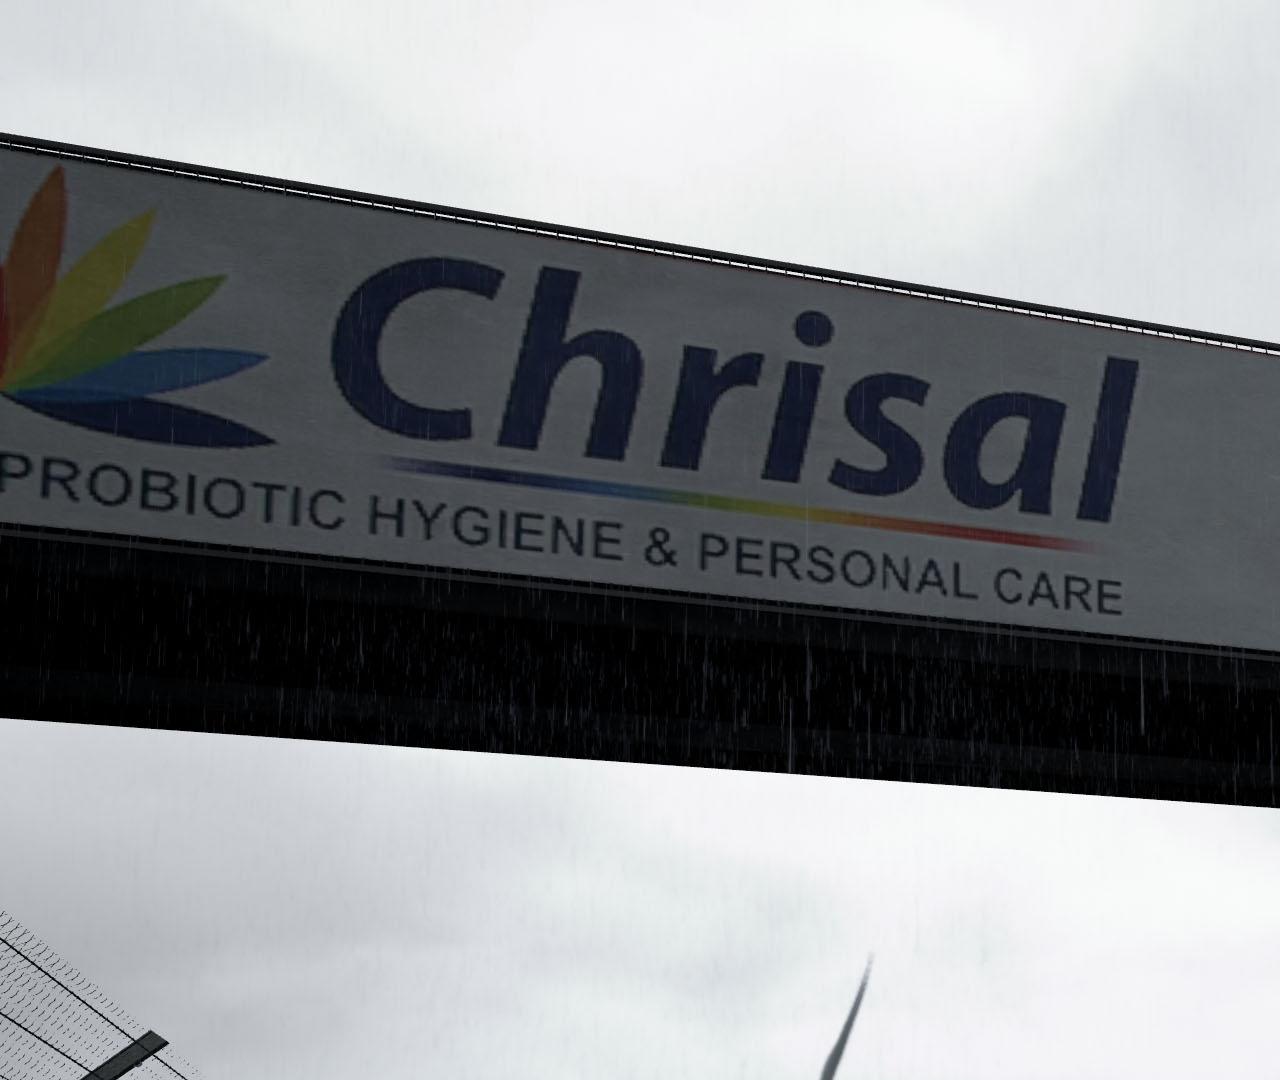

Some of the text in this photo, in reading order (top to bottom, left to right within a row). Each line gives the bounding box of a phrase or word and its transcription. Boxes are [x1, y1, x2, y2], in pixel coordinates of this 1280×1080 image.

[332, 256, 1139, 523] Chrisal
[0, 453, 1124, 616] PROBIOTIC HYGIENE & PERSONAL CARE
